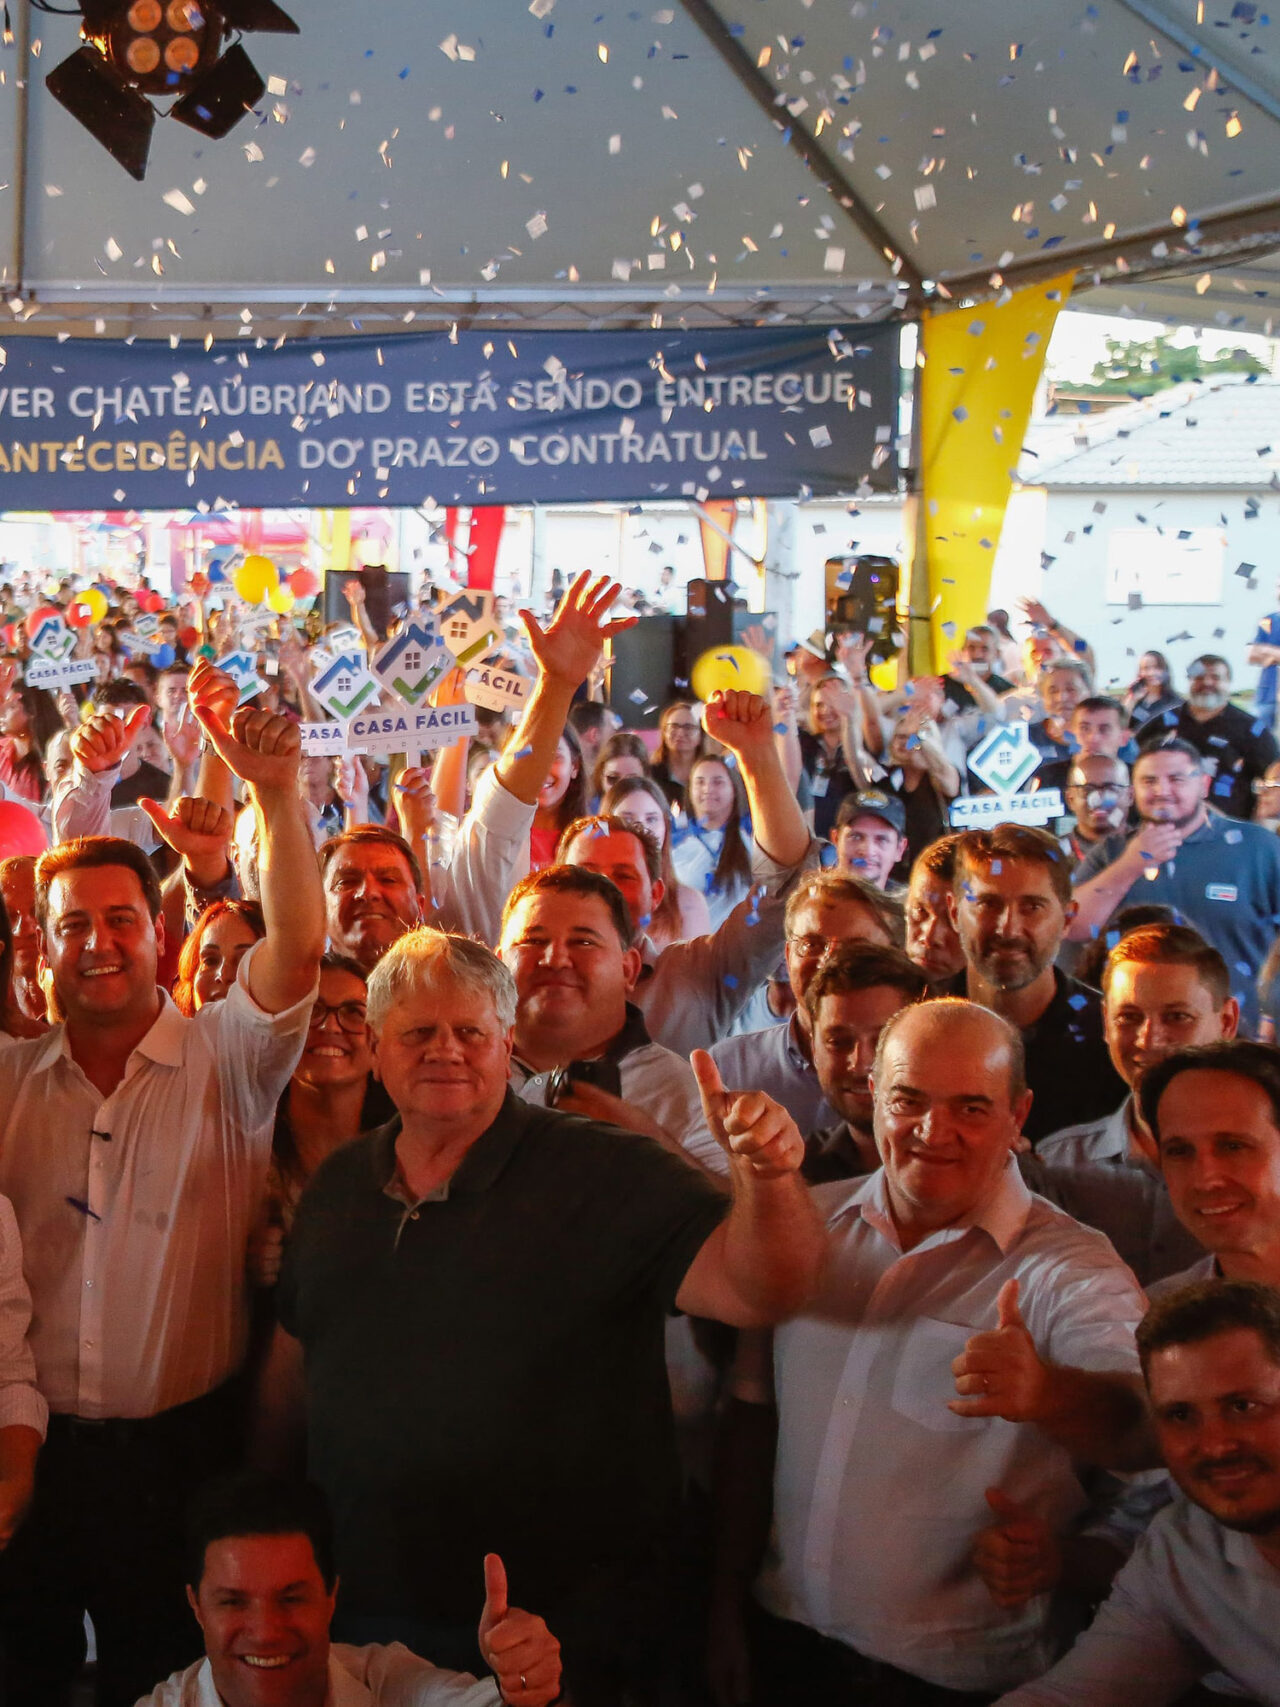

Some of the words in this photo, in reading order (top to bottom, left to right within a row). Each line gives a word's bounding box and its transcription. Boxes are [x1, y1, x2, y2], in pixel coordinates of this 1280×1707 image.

[69, 383, 391, 419] CHATEAUBRIAND
[406, 371, 498, 413] ESTÁ
[511, 377, 642, 412] SENDO
[656, 372, 854, 408] ENTREGUE
[299, 438, 357, 470] DO
[372, 436, 500, 470] PRAZO
[516, 429, 768, 468] CONTRATUAL
[29, 669, 58, 680] CASA
[353, 717, 408, 736] CASA
[416, 710, 471, 729] FÁCIL
[960, 802, 1003, 815] CASA
